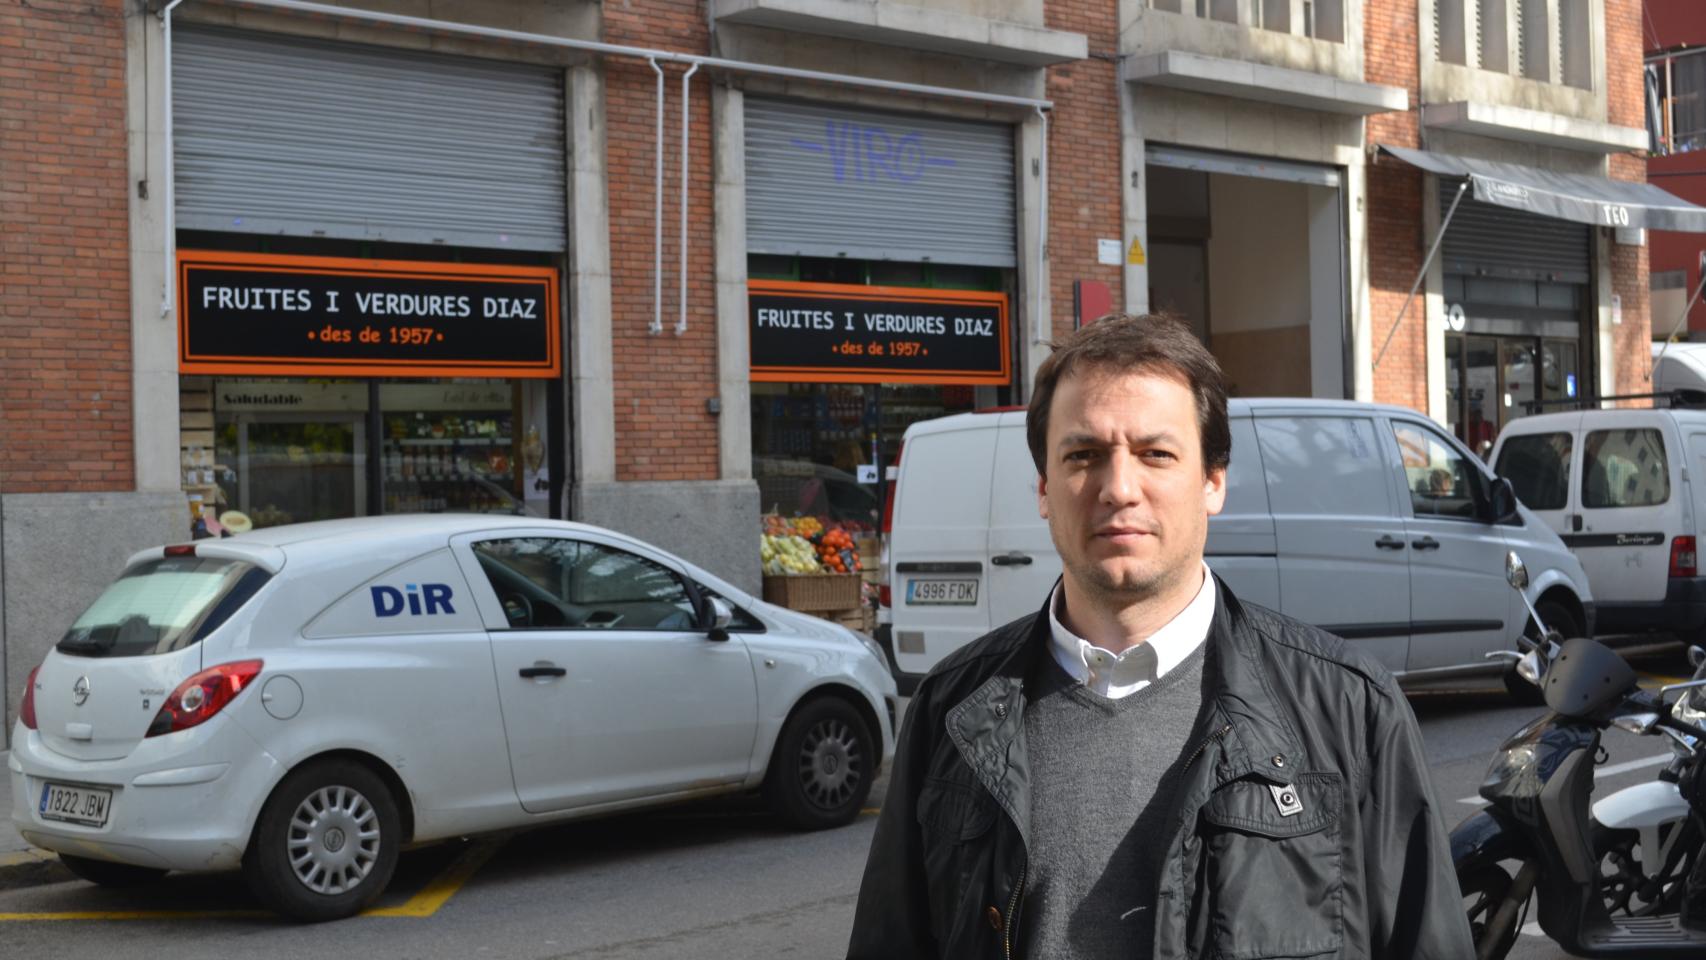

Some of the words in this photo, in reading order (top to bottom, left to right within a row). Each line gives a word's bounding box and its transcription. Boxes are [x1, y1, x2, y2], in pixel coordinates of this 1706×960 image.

[1603, 205, 1629, 226] TEO
[203, 287, 312, 311] FRUITES
[325, 291, 340, 312] I
[355, 293, 471, 317] VERDURES
[483, 298, 537, 319] DIAZ
[757, 308, 835, 330] FRUITES
[844, 313, 855, 331] I
[864, 313, 946, 335] VERDURES
[954, 318, 993, 336] DIAZ
[320, 325, 352, 342] des
[359, 326, 381, 343] de
[389, 327, 433, 344] 1957
[841, 340, 863, 355] des
[868, 342, 884, 356] de
[889, 342, 921, 356] 1957
[915, 583, 946, 599] 4996
[949, 583, 974, 600] FDK
[49, 789, 79, 814] 1822
[80, 794, 106, 818] JBM
